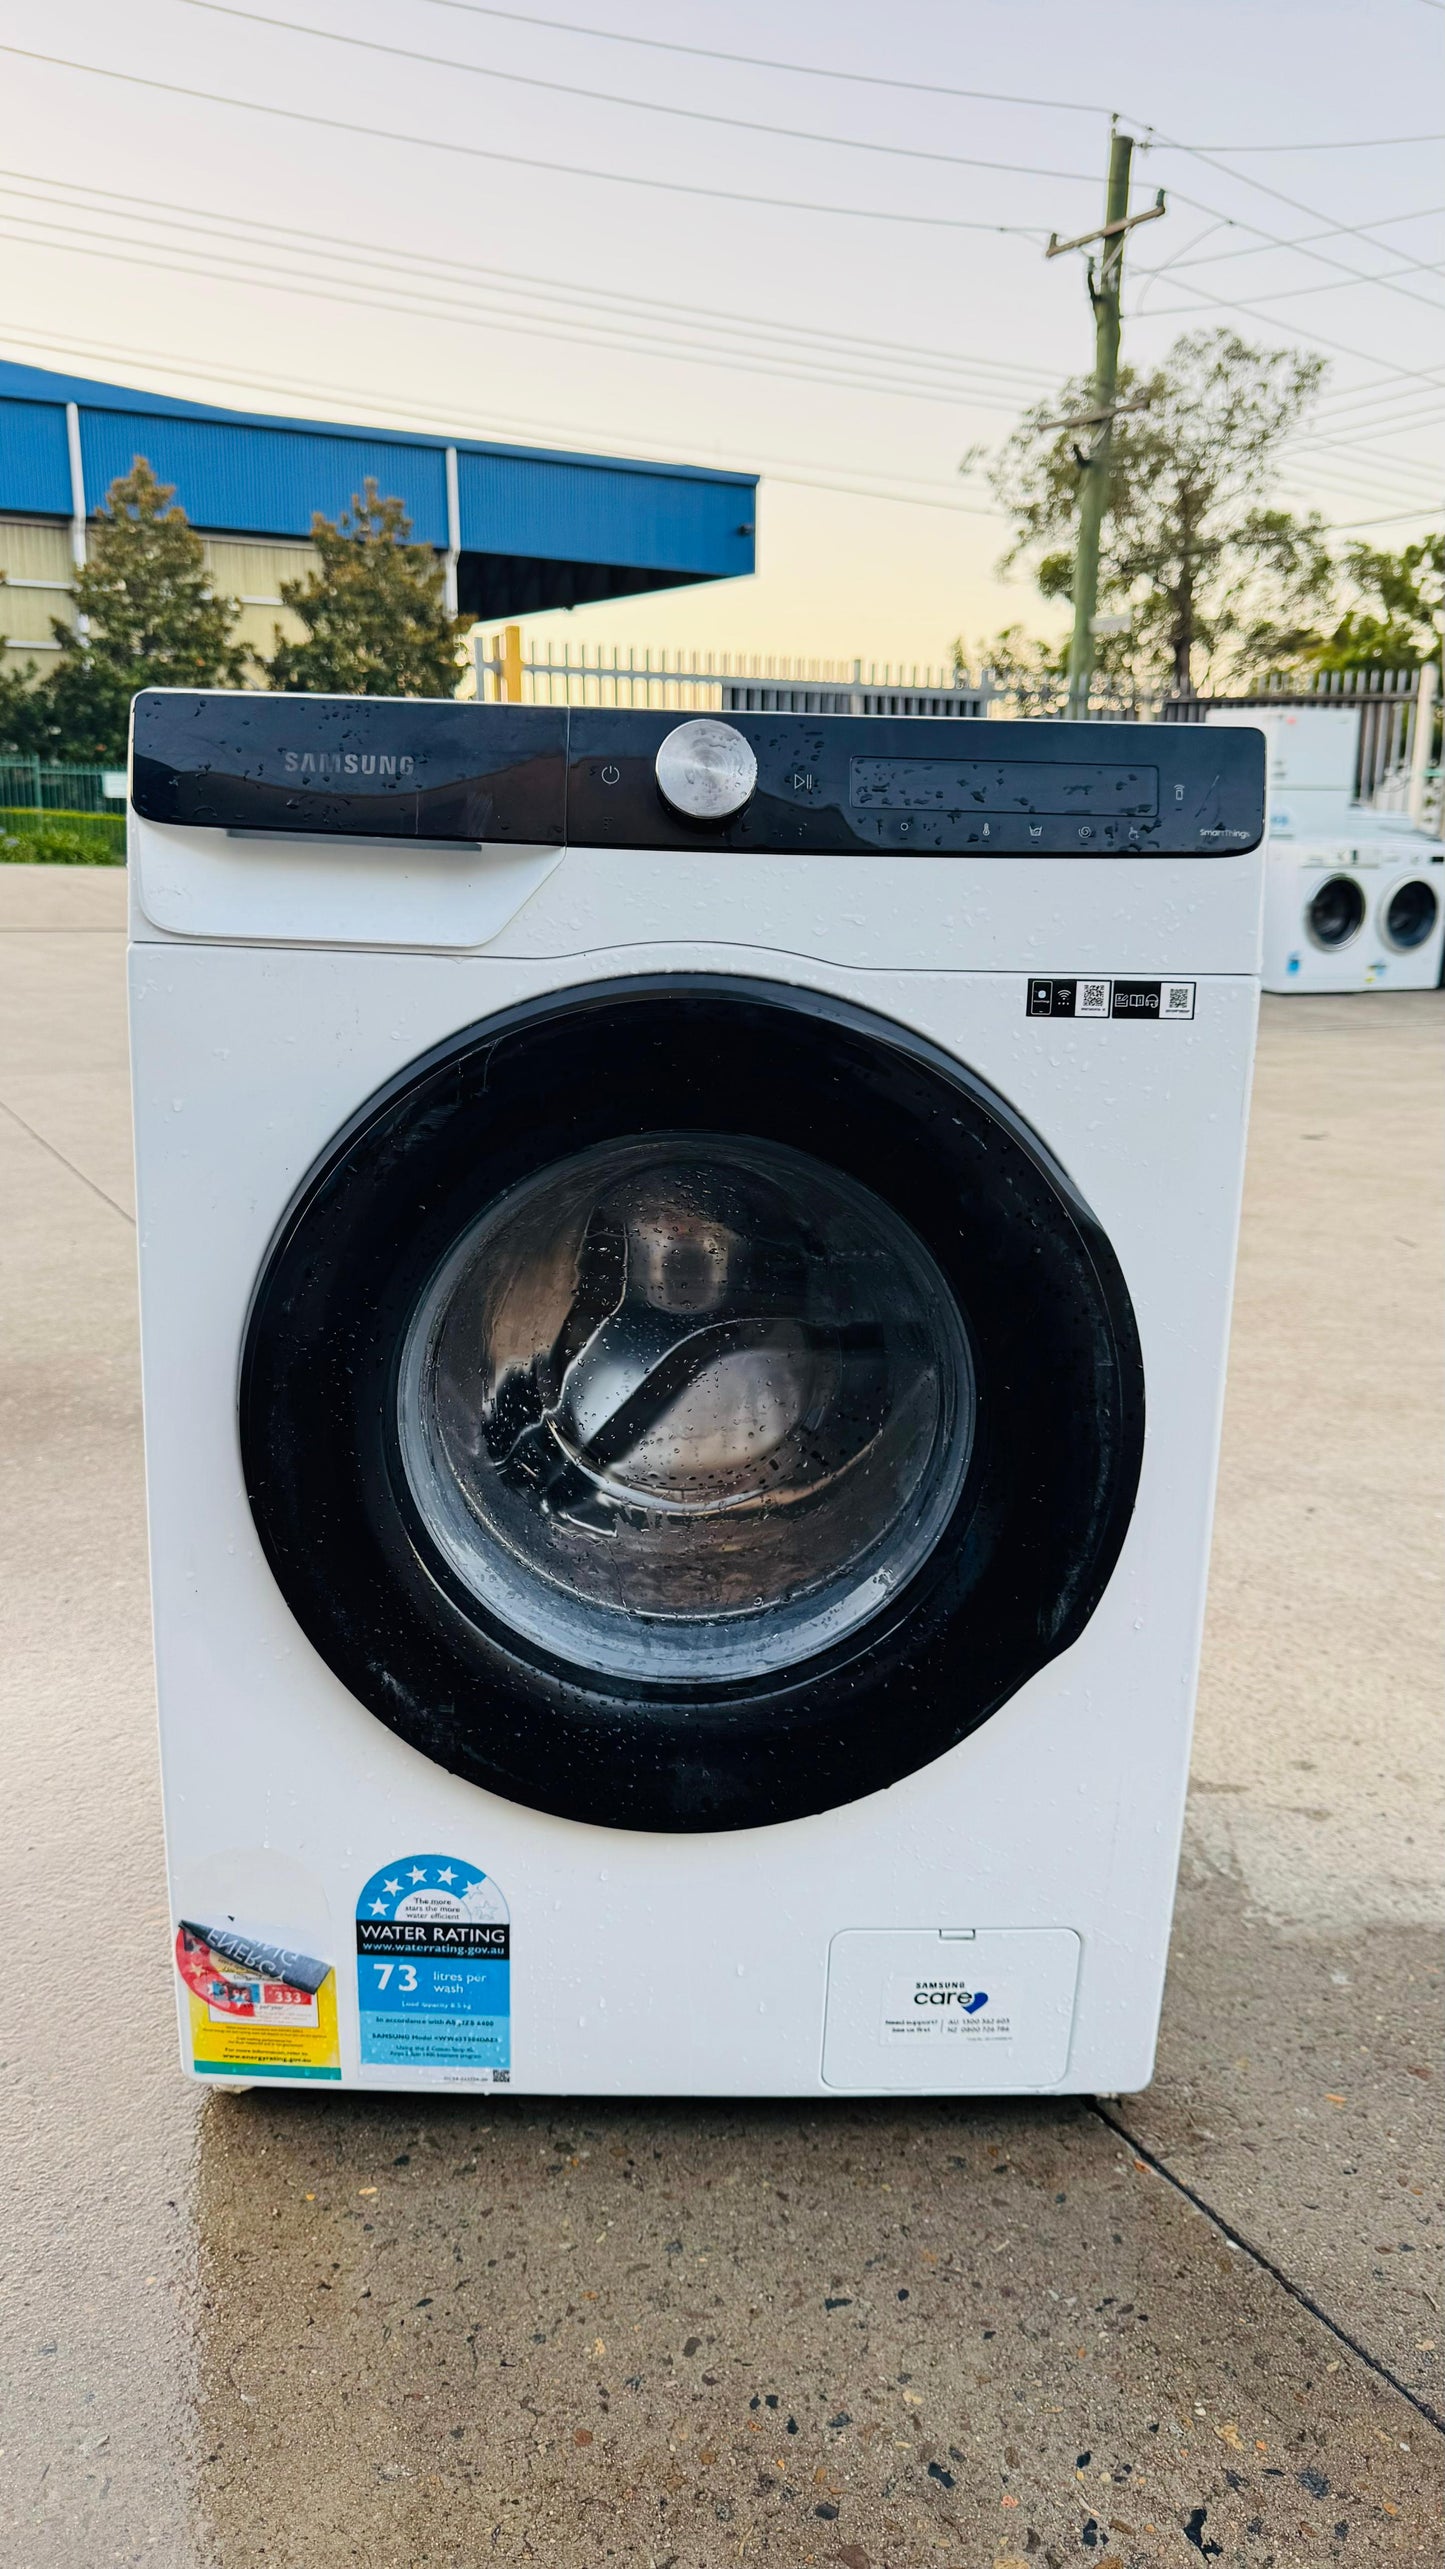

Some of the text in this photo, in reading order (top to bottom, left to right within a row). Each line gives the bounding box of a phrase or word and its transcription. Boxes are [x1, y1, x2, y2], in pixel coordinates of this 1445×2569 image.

[285, 752, 414, 775] SAMSUNG
[1200, 829, 1250, 840] SmartThings
[360, 1925, 505, 1943] WATER RATING
[363, 1942, 505, 1956] www.waterrating.gov.au
[373, 1963, 418, 1991] 73
[433, 1971, 487, 1984] litres per
[433, 1984, 464, 1994] wash
[274, 1991, 302, 2003] 333
[914, 1991, 973, 2005] care
[384, 2017, 426, 2025] accordance
